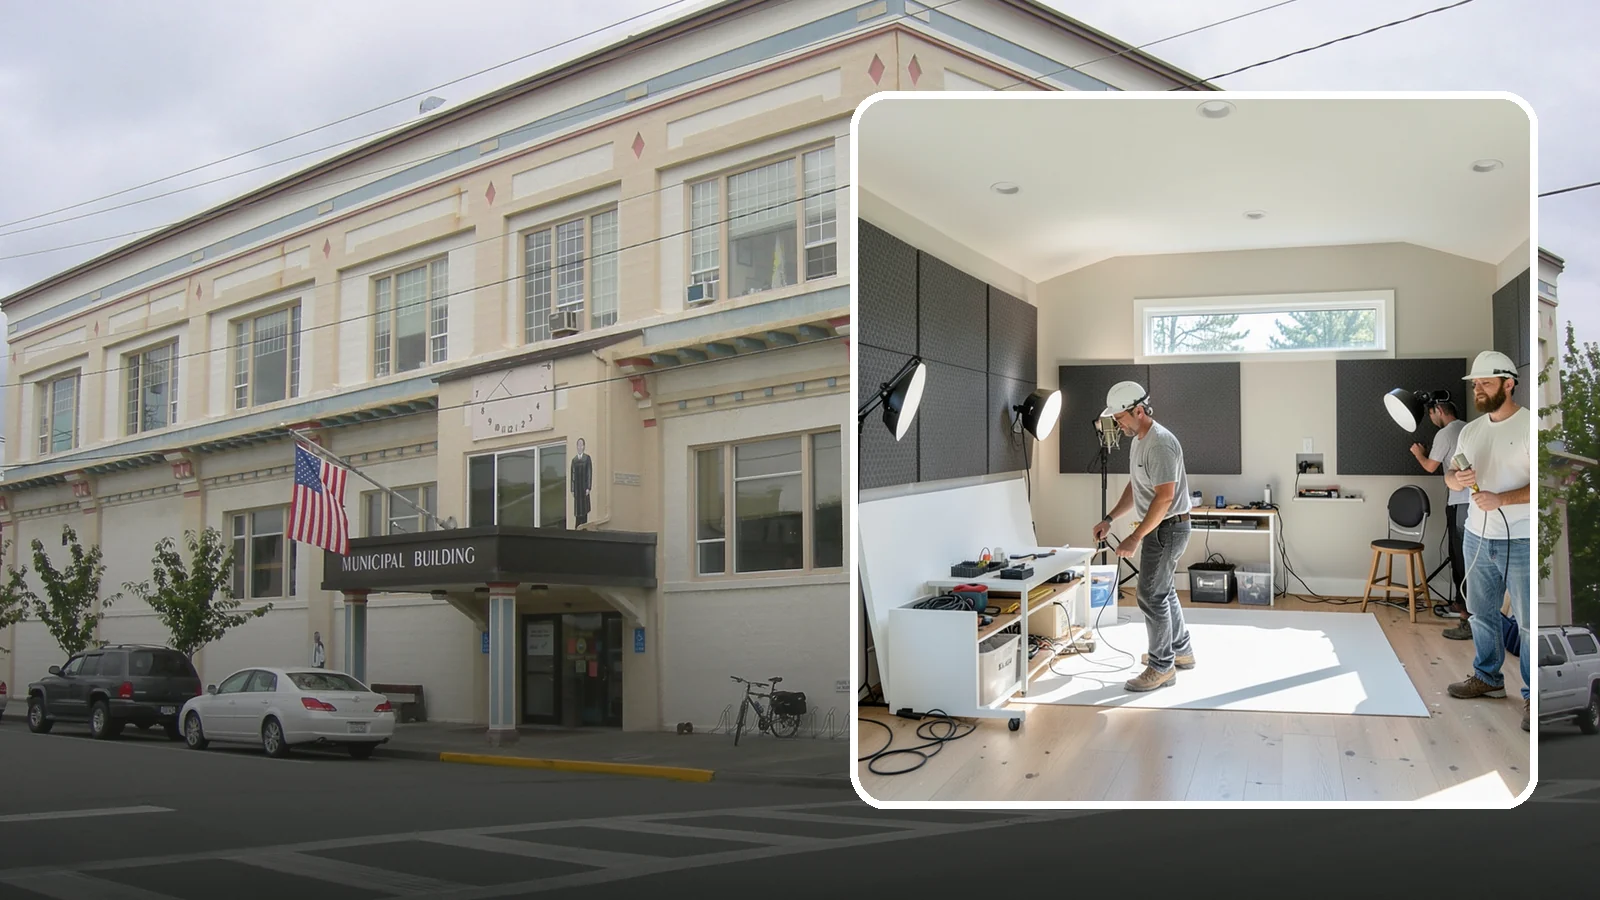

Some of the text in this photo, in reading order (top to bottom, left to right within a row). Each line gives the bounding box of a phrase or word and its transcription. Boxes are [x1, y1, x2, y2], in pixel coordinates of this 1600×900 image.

[547, 362, 551, 370] 6
[536, 402, 540, 410] 4
[480, 407, 485, 415] 8
[495, 423, 500, 431] 10
[521, 420, 525, 428] 2
[507, 425, 513, 433] 12
[342, 546, 475, 571] MUNICIPAL BUILDING
